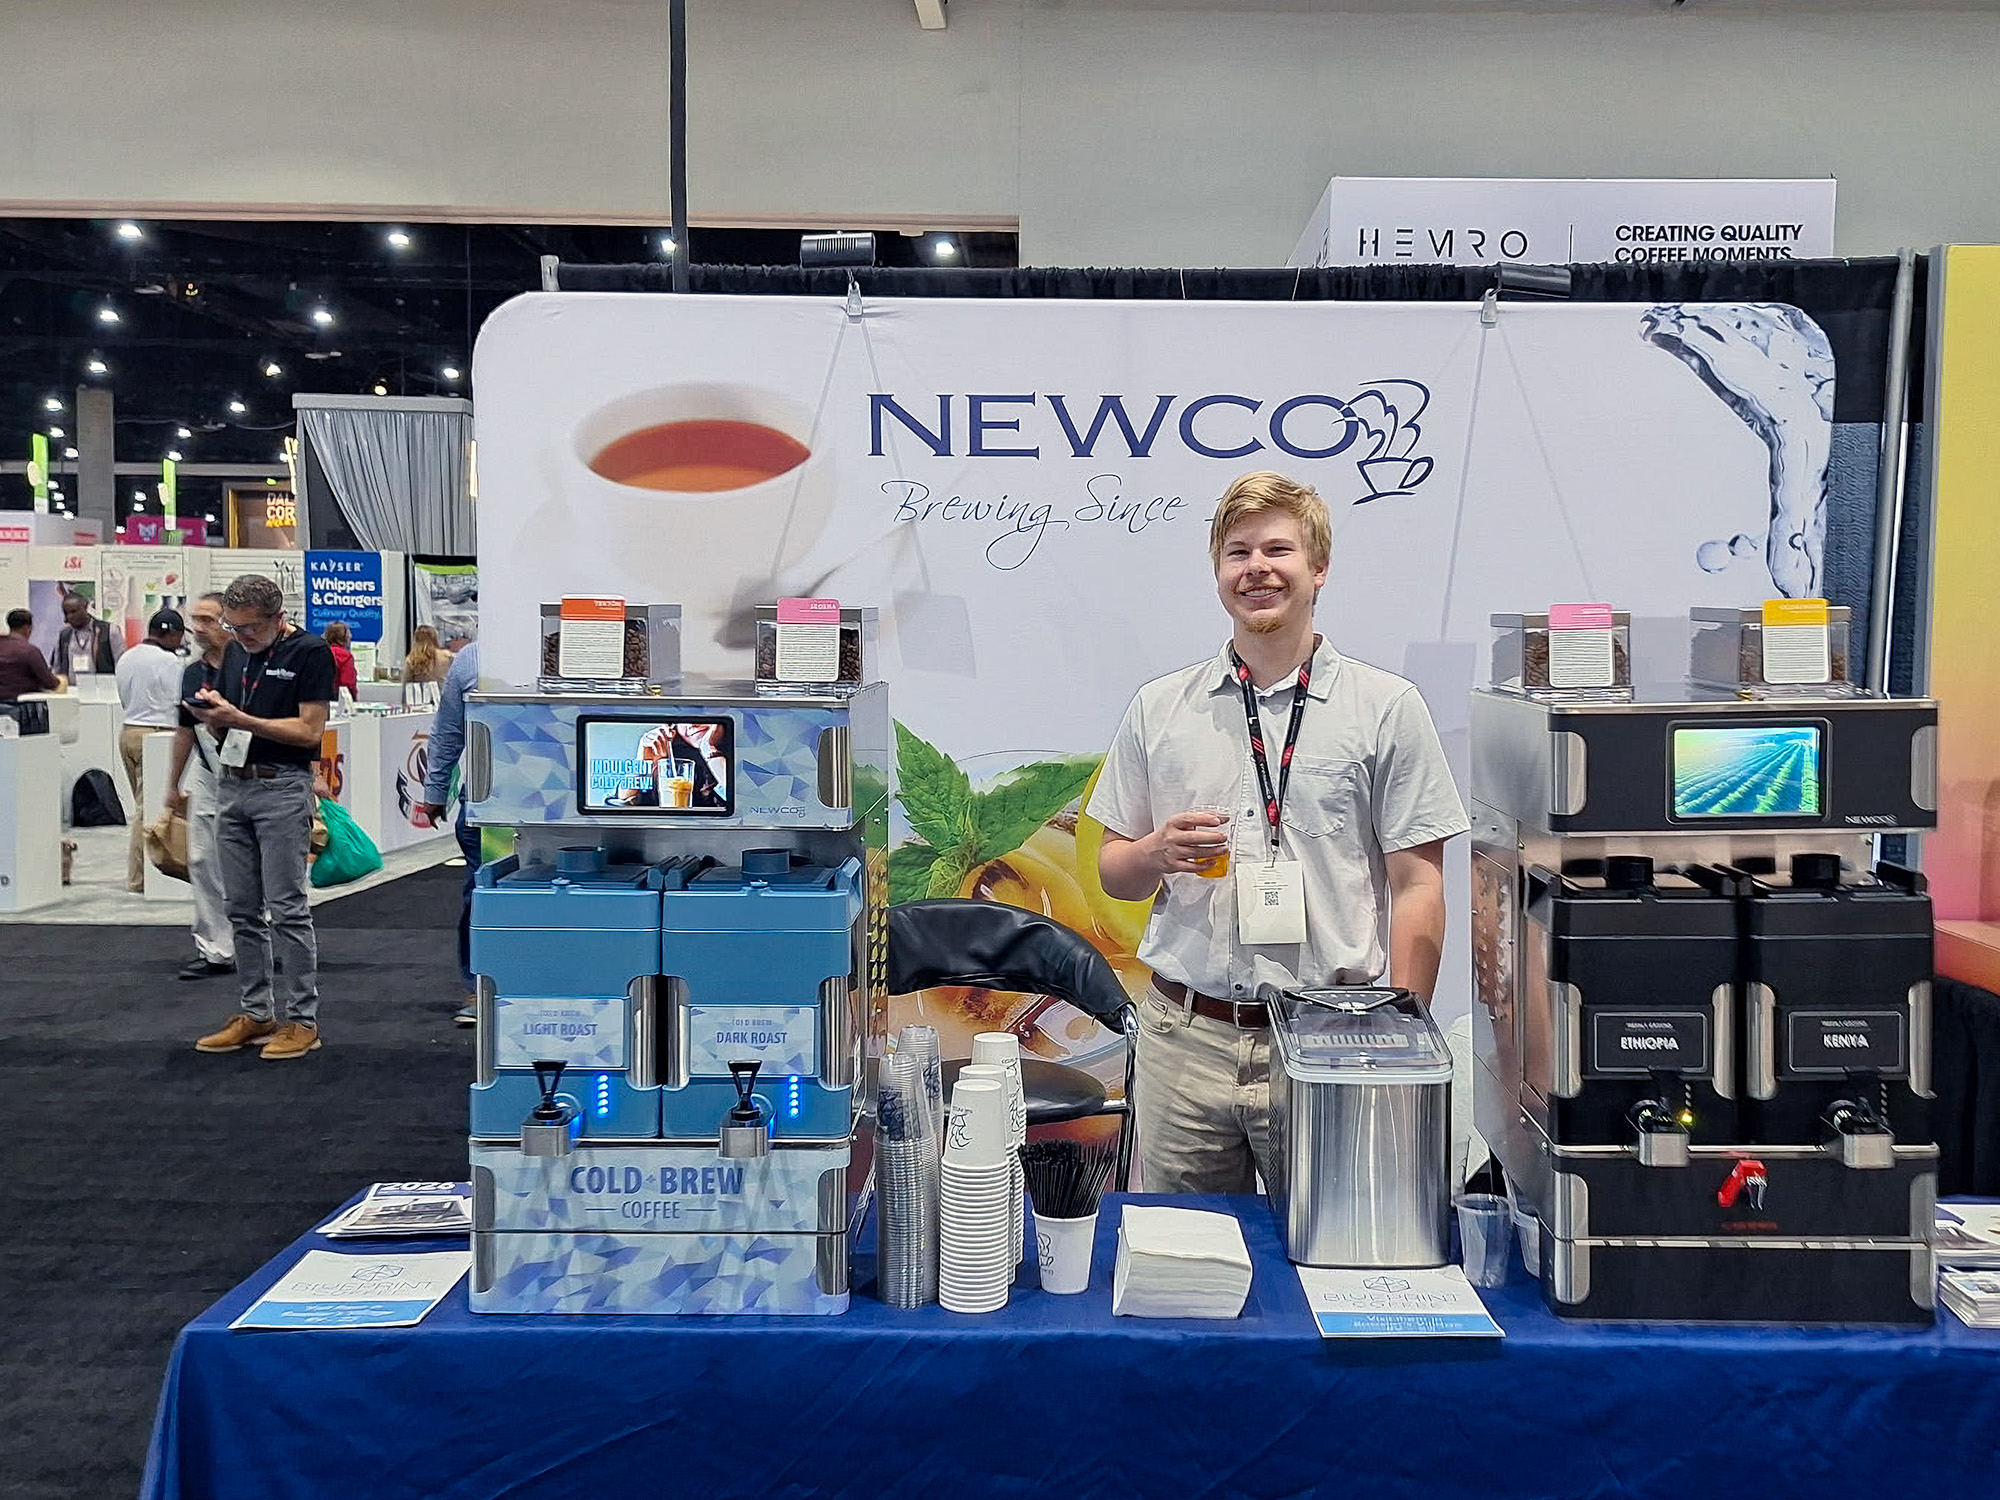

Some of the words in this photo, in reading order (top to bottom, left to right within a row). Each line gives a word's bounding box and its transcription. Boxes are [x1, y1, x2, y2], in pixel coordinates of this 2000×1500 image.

[1615, 225, 1715, 242] CREATING
[1720, 224, 1803, 241] QUALITY
[1358, 228, 1529, 258] HEMRO
[1614, 247, 1687, 263] COFFEE
[1693, 246, 1792, 262] MOMENTS
[866, 391, 1361, 459] NEWCO
[880, 479, 1070, 571] Brewing
[1074, 472, 1189, 533] Since
[310, 558, 362, 572] KAYSER
[311, 577, 376, 593] Whippers
[311, 592, 322, 605] &
[323, 592, 383, 608] Chargers
[590, 759, 654, 774] INDULGENT
[750, 806, 799, 814] NEWCO
[523, 1023, 558, 1036] LIGHT
[560, 1023, 599, 1036] ROAST
[716, 1031, 748, 1044] DARK
[750, 1031, 788, 1044] ROAST
[1620, 1036, 1680, 1050] ETHIOPIA
[1823, 1033, 1870, 1049] KENYA
[570, 1166, 643, 1195] COLD
[659, 1166, 746, 1195] BREW
[621, 1201, 681, 1219] COFFEE
